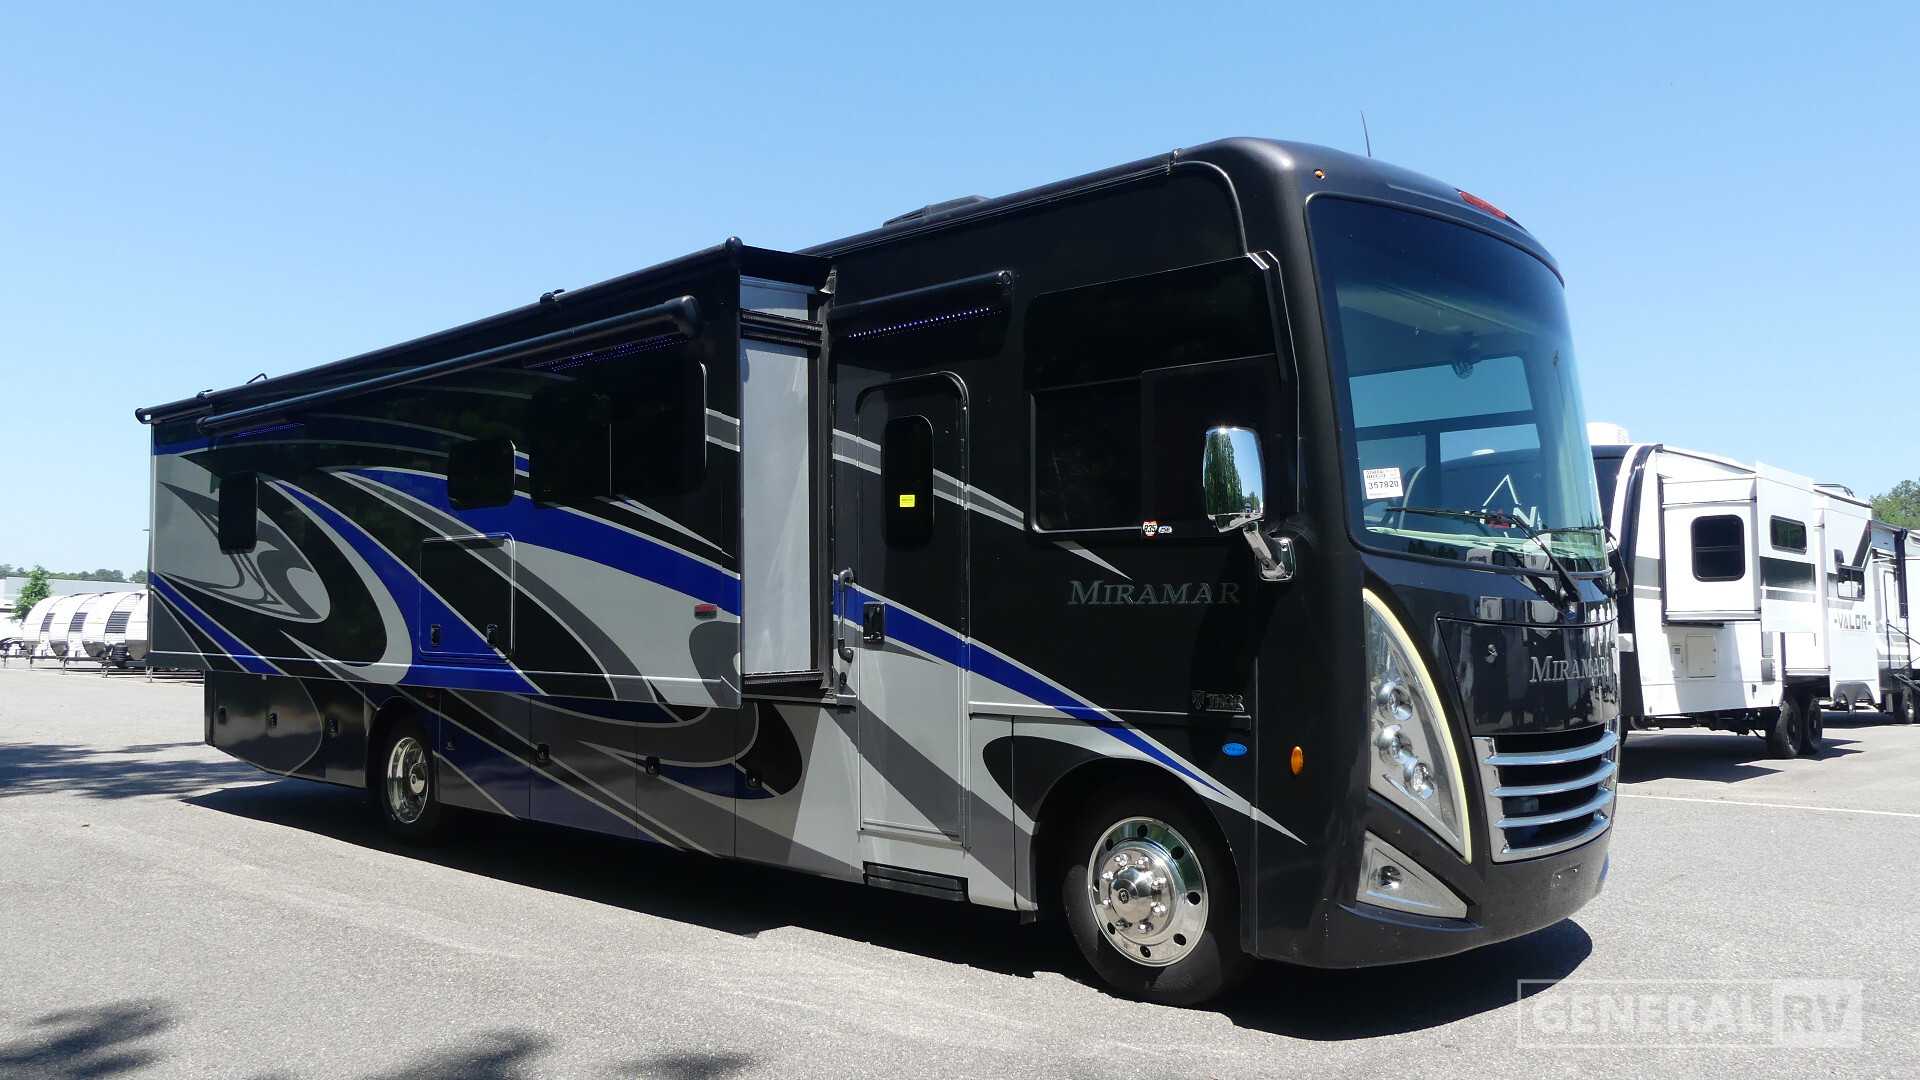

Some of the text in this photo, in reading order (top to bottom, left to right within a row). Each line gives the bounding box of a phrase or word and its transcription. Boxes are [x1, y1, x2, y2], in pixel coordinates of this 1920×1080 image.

[1067, 579, 1240, 605] MIRAMAR
[1529, 655, 1608, 683] MIRAMAR
[1205, 693, 1245, 712] THOR
